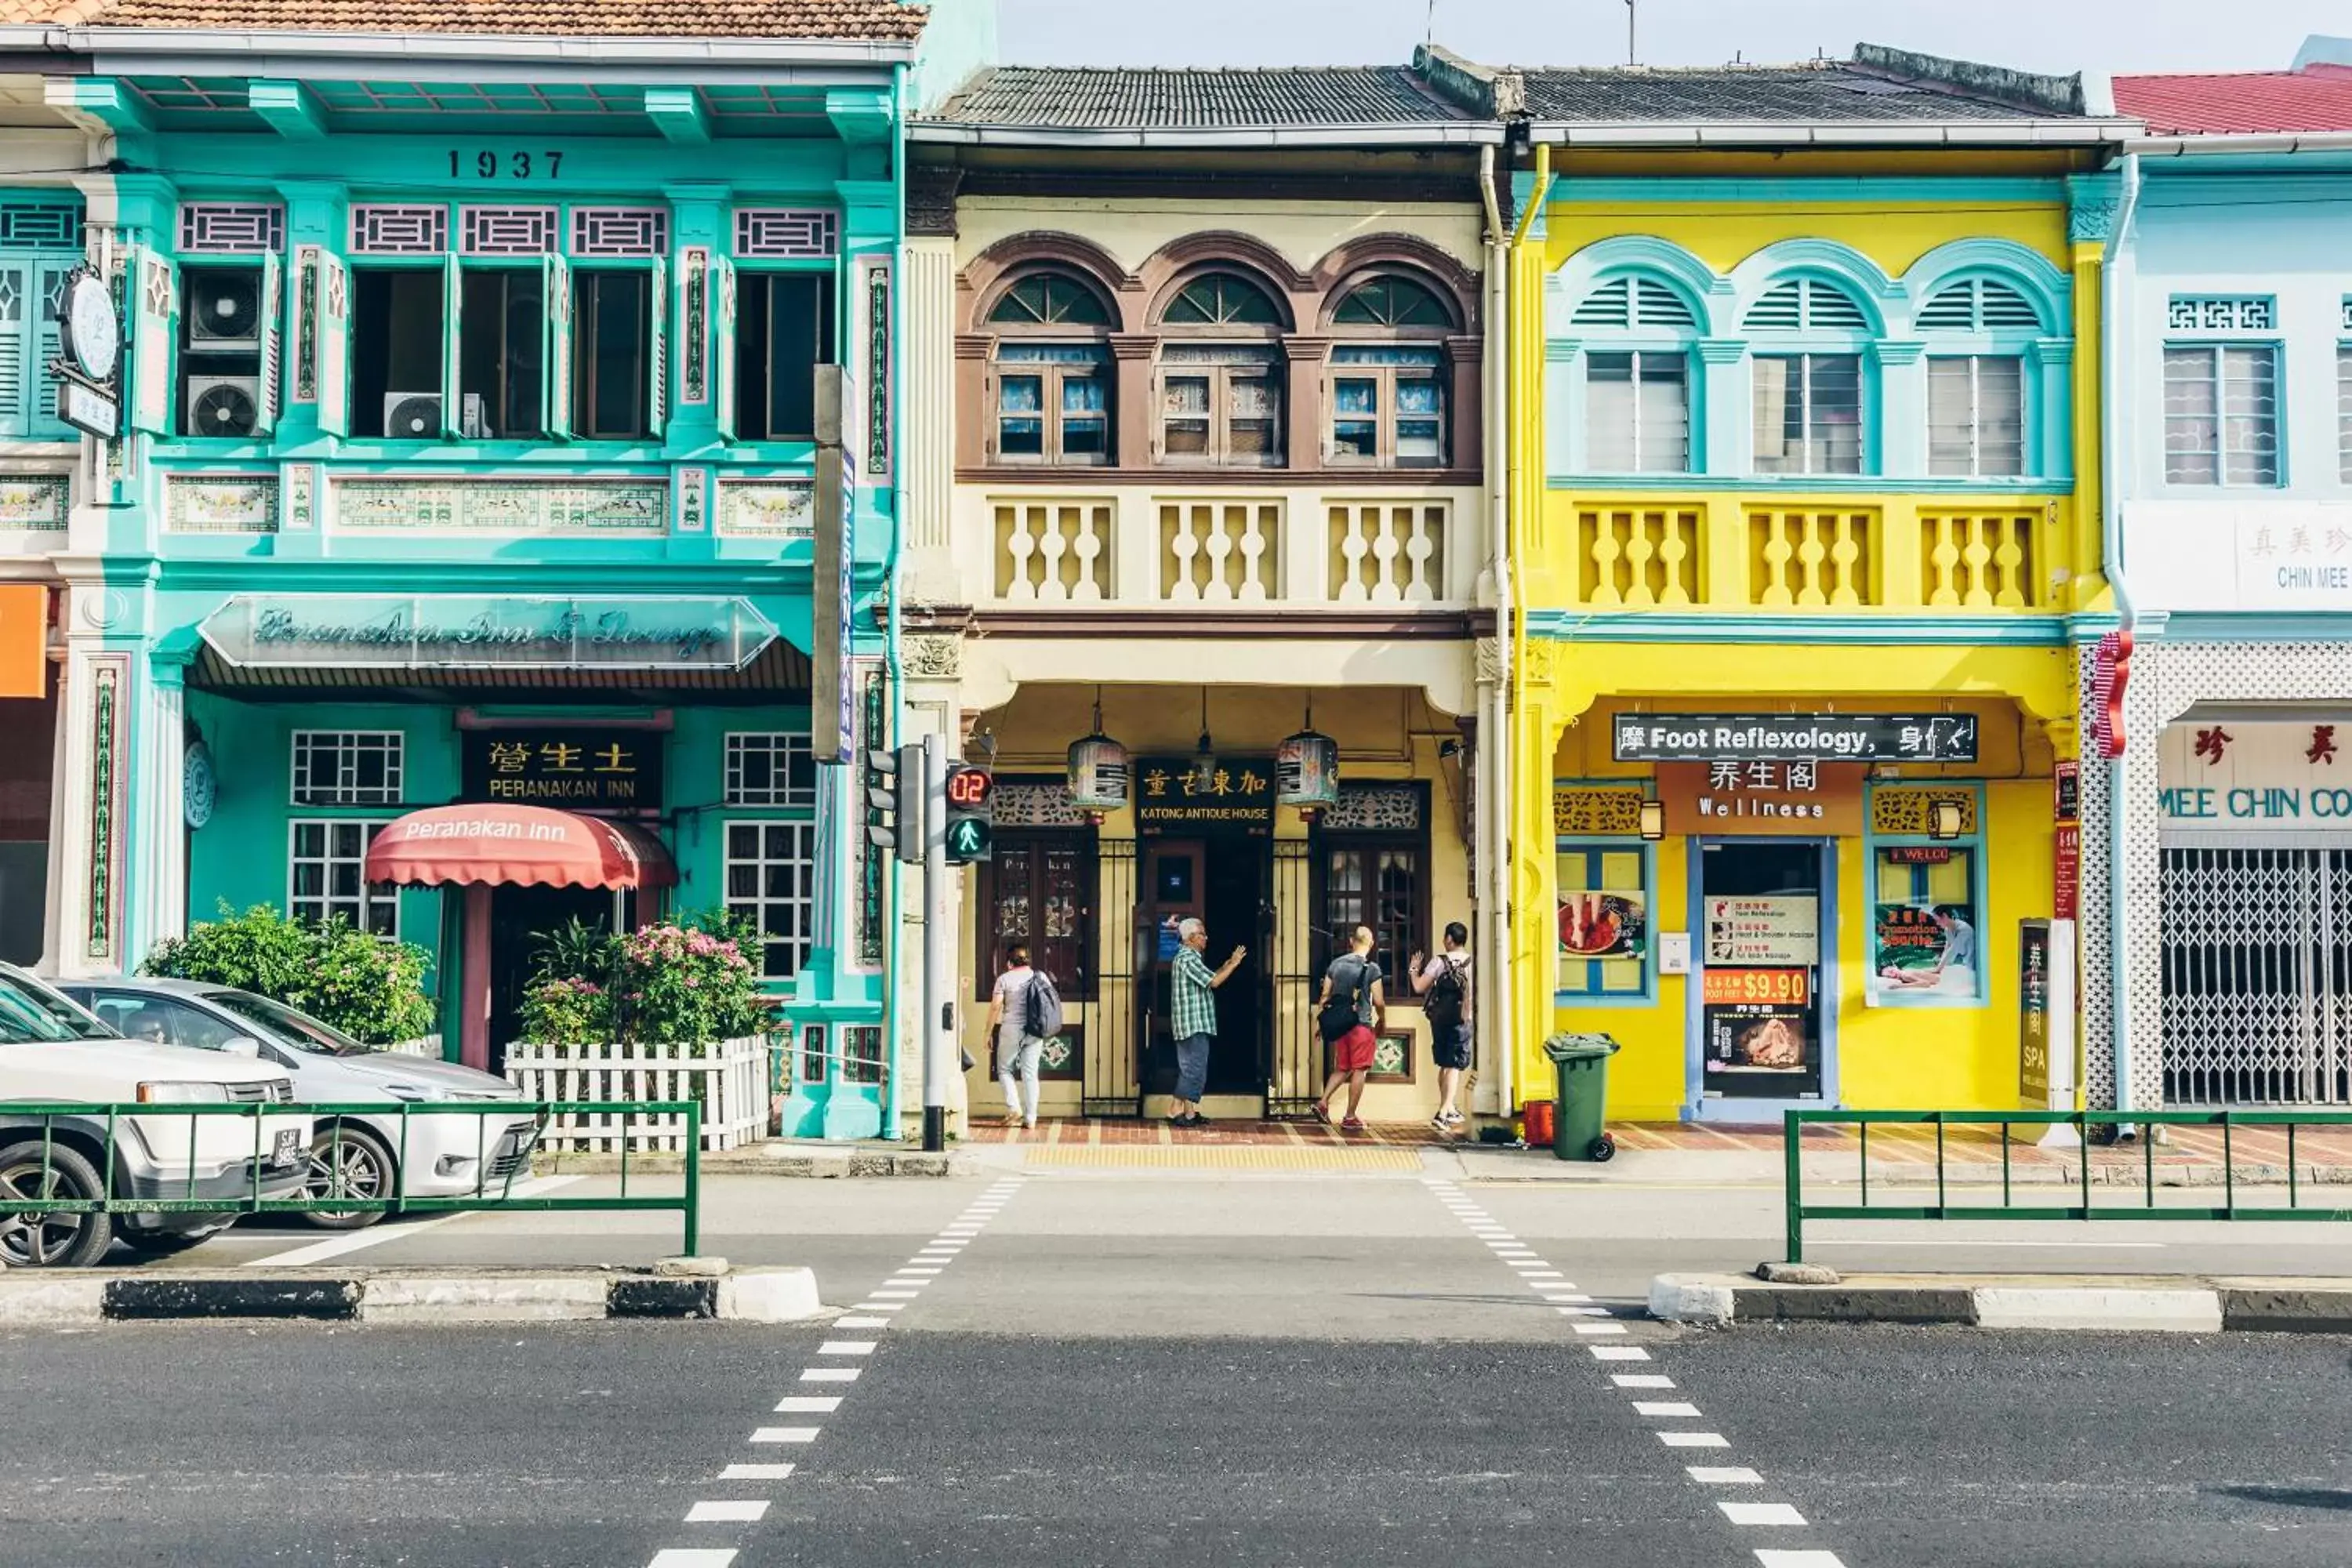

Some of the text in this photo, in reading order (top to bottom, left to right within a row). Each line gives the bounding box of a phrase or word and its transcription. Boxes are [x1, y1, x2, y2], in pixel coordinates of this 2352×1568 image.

[448, 149, 564, 180] 1937
[2277, 566, 2349, 589] CHIN MEE
[456, 610, 535, 644] Inn
[591, 609, 722, 659] Lounge
[1650, 727, 1709, 749] Foot
[489, 779, 635, 798] PERANAKAN INN
[952, 774, 984, 802] 02
[1710, 760, 1818, 791] 养生阁
[1141, 808, 1269, 820] KATONG ANTIQUE HOUSE
[1698, 797, 1824, 818] Wellness
[2227, 788, 2299, 818] CHIN
[1744, 972, 1805, 1000] $9.90
[2024, 1045, 2045, 1070] SPA
